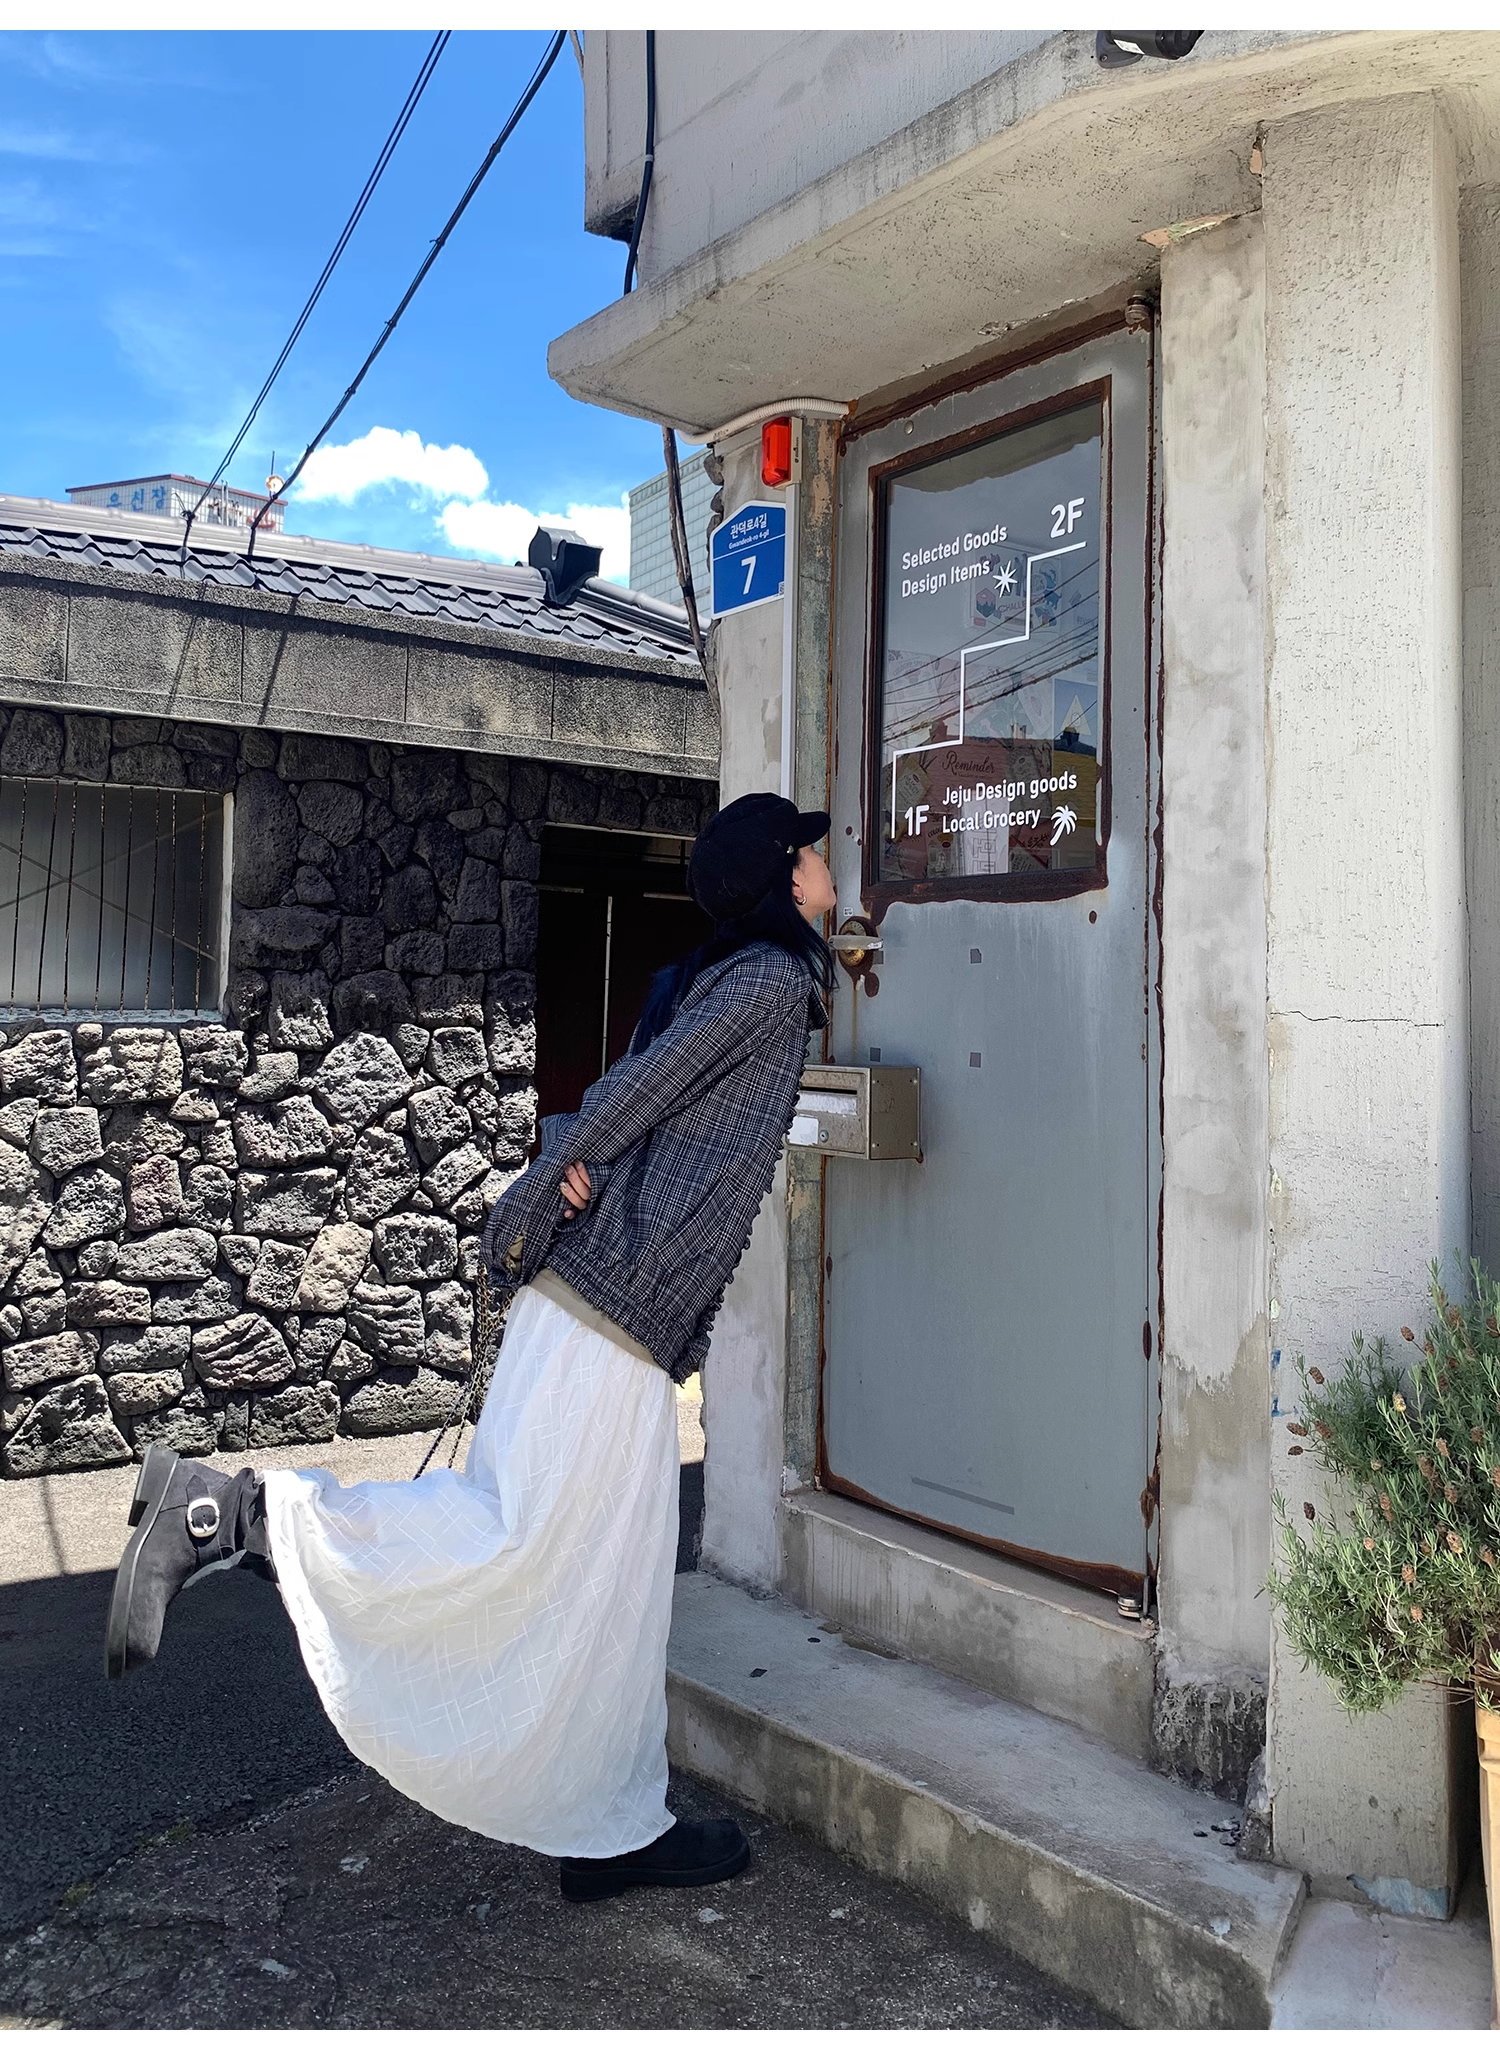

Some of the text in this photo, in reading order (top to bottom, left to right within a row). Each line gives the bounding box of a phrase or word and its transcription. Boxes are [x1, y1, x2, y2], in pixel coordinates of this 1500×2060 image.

[730, 513, 767, 539] 관덕로4길
[1050, 497, 1086, 538] 2F
[728, 528, 770, 550] Gwandeok-ro 4-gil
[902, 524, 1007, 570] Selected Goods
[741, 555, 757, 595] 7
[902, 560, 991, 598] Design Items
[941, 750, 995, 775] Reminder
[942, 786, 971, 809] Jeju
[975, 779, 1025, 802] Design
[1029, 770, 1078, 800] goods
[904, 804, 930, 837] 1F
[942, 809, 1041, 834] Local Grocery
